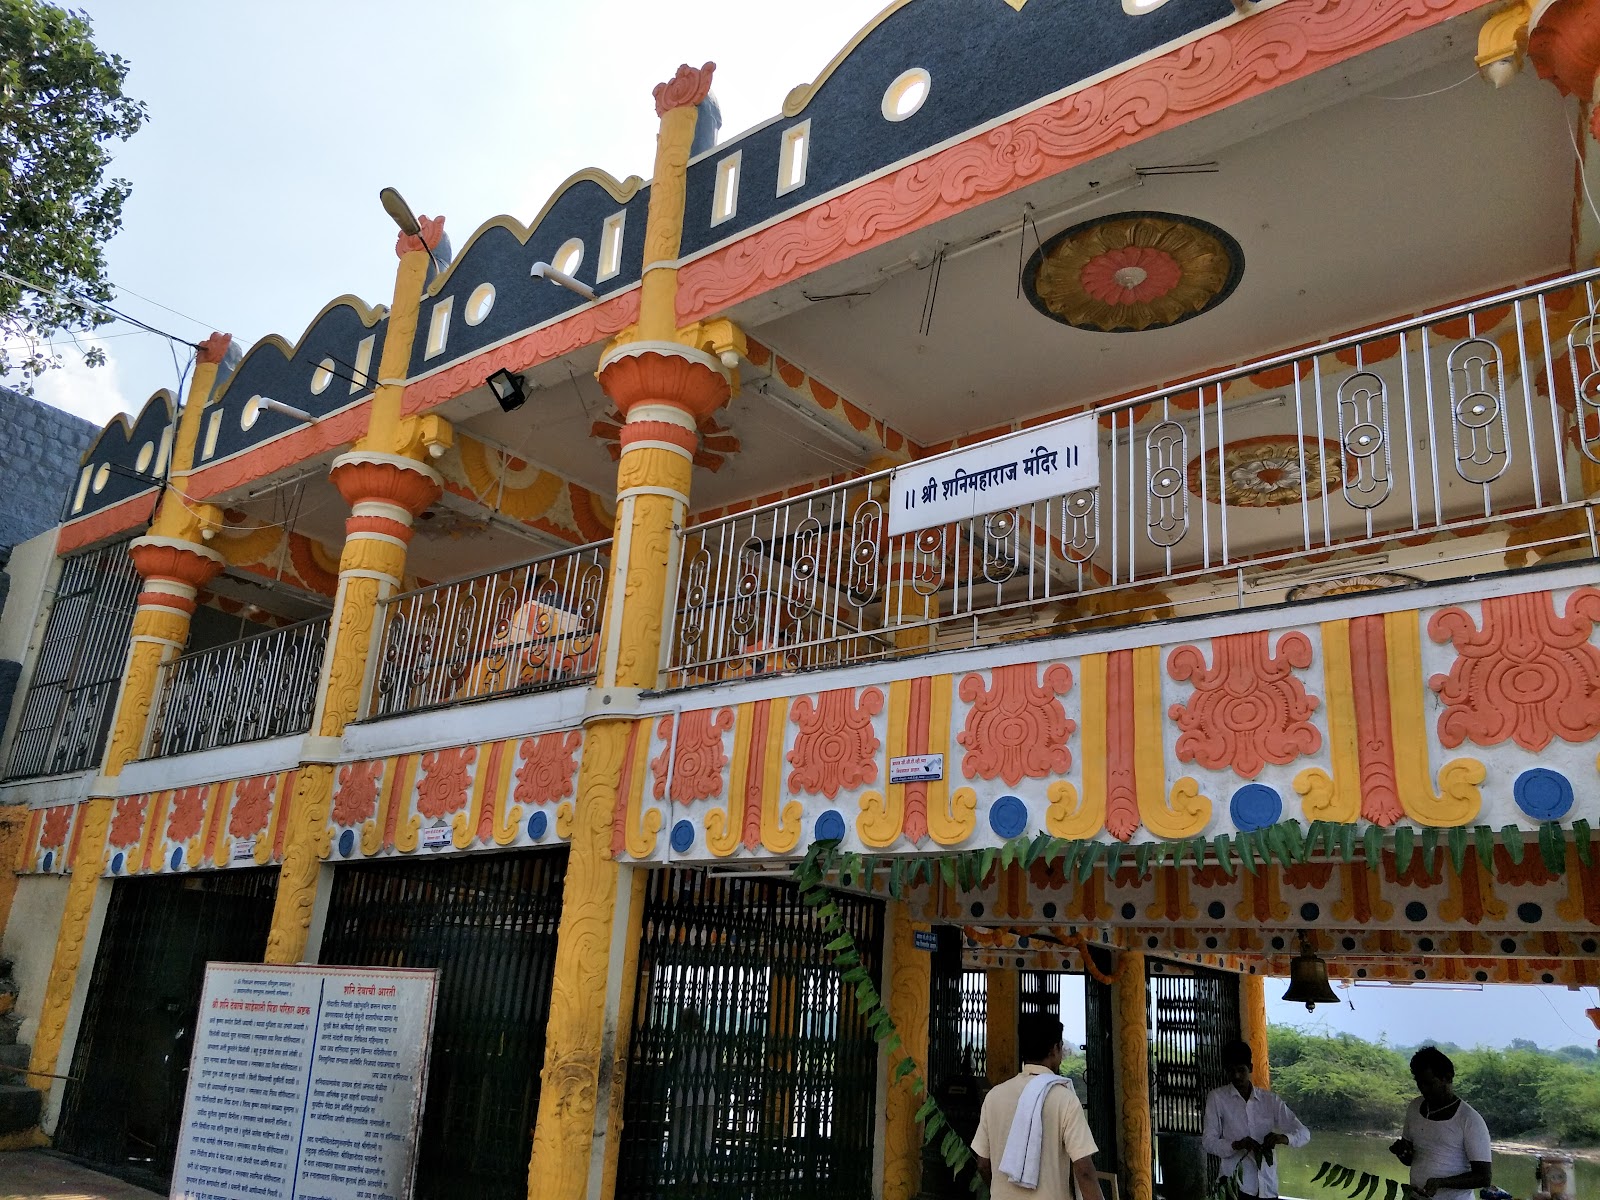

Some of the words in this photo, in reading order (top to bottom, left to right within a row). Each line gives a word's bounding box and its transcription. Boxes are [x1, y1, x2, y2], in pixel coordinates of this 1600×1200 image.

[921, 477, 937, 504] श्री
[942, 462, 1017, 500] शनिमहाराज
[1023, 446, 1058, 477] मंदिर
[344, 983, 355, 995] शनि
[358, 984, 375, 996] देवाची
[378, 985, 396, 997] आरती
[220, 998, 229, 1009] शनि
